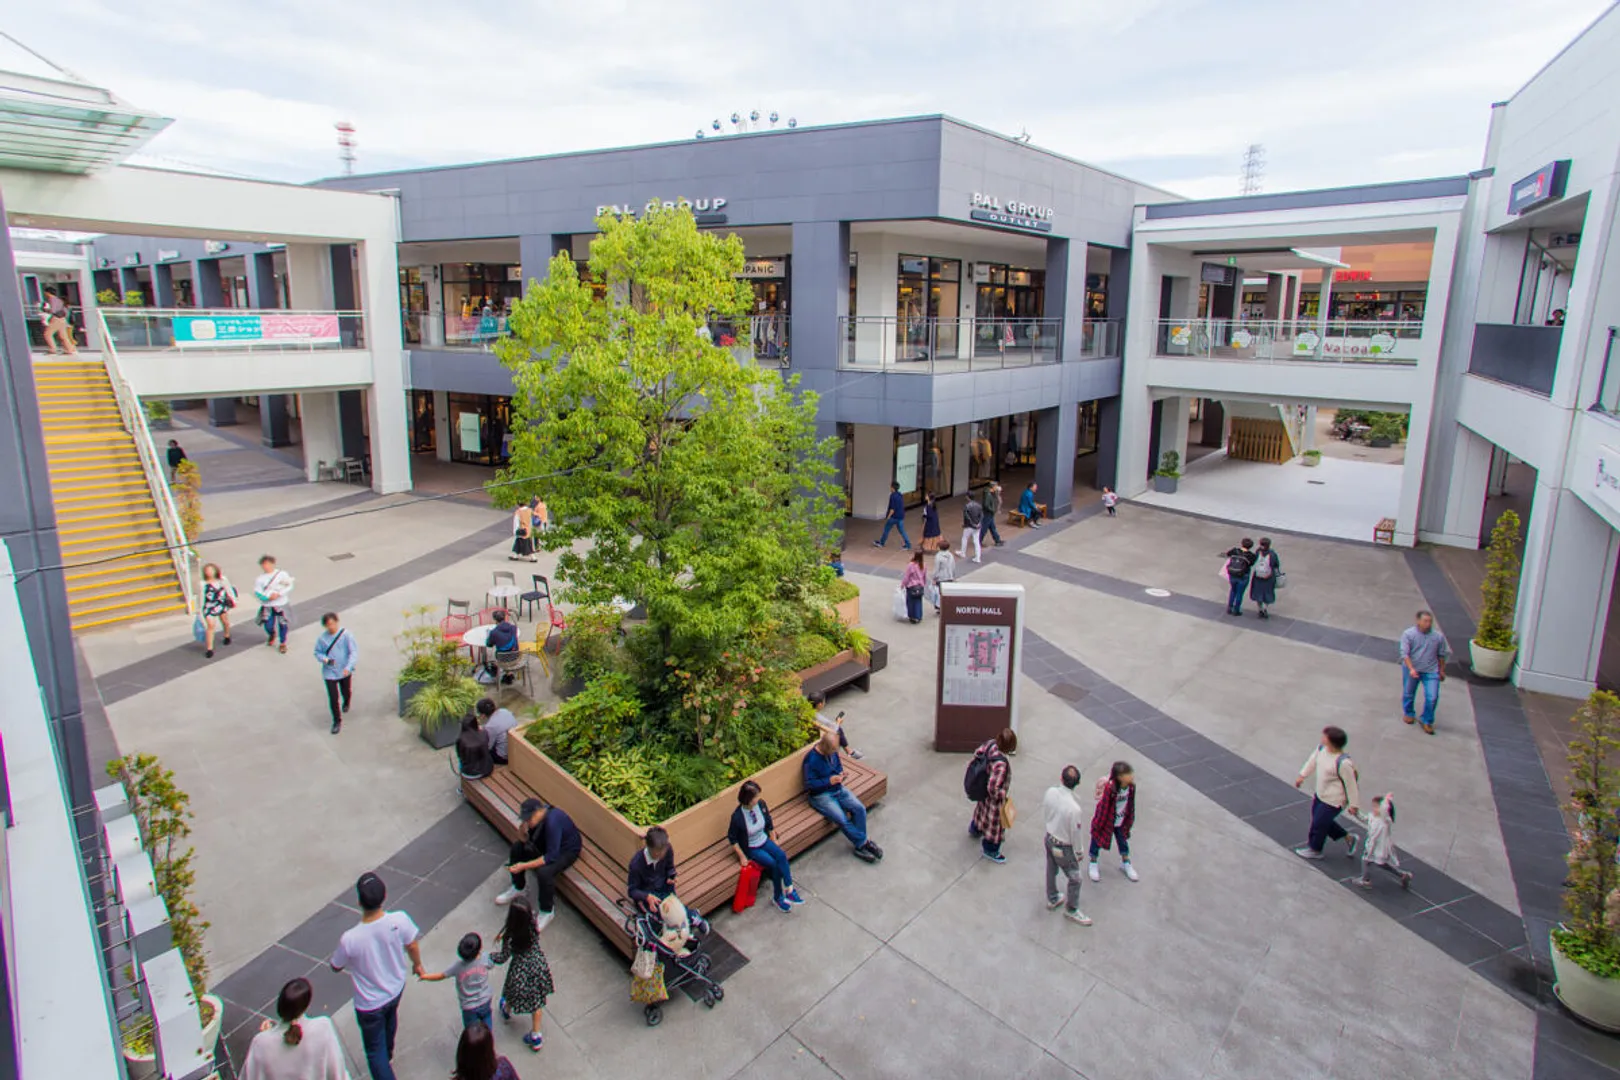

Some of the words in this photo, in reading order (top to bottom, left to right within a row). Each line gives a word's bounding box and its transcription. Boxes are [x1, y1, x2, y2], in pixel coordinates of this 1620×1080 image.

[973, 192, 1001, 209] PAL
[1008, 200, 1054, 219] GROUP
[989, 213, 1038, 228] OUTLET
[742, 264, 774, 274] PANIC
[955, 606, 981, 615] NORTH
[982, 607, 1002, 616] MALL
